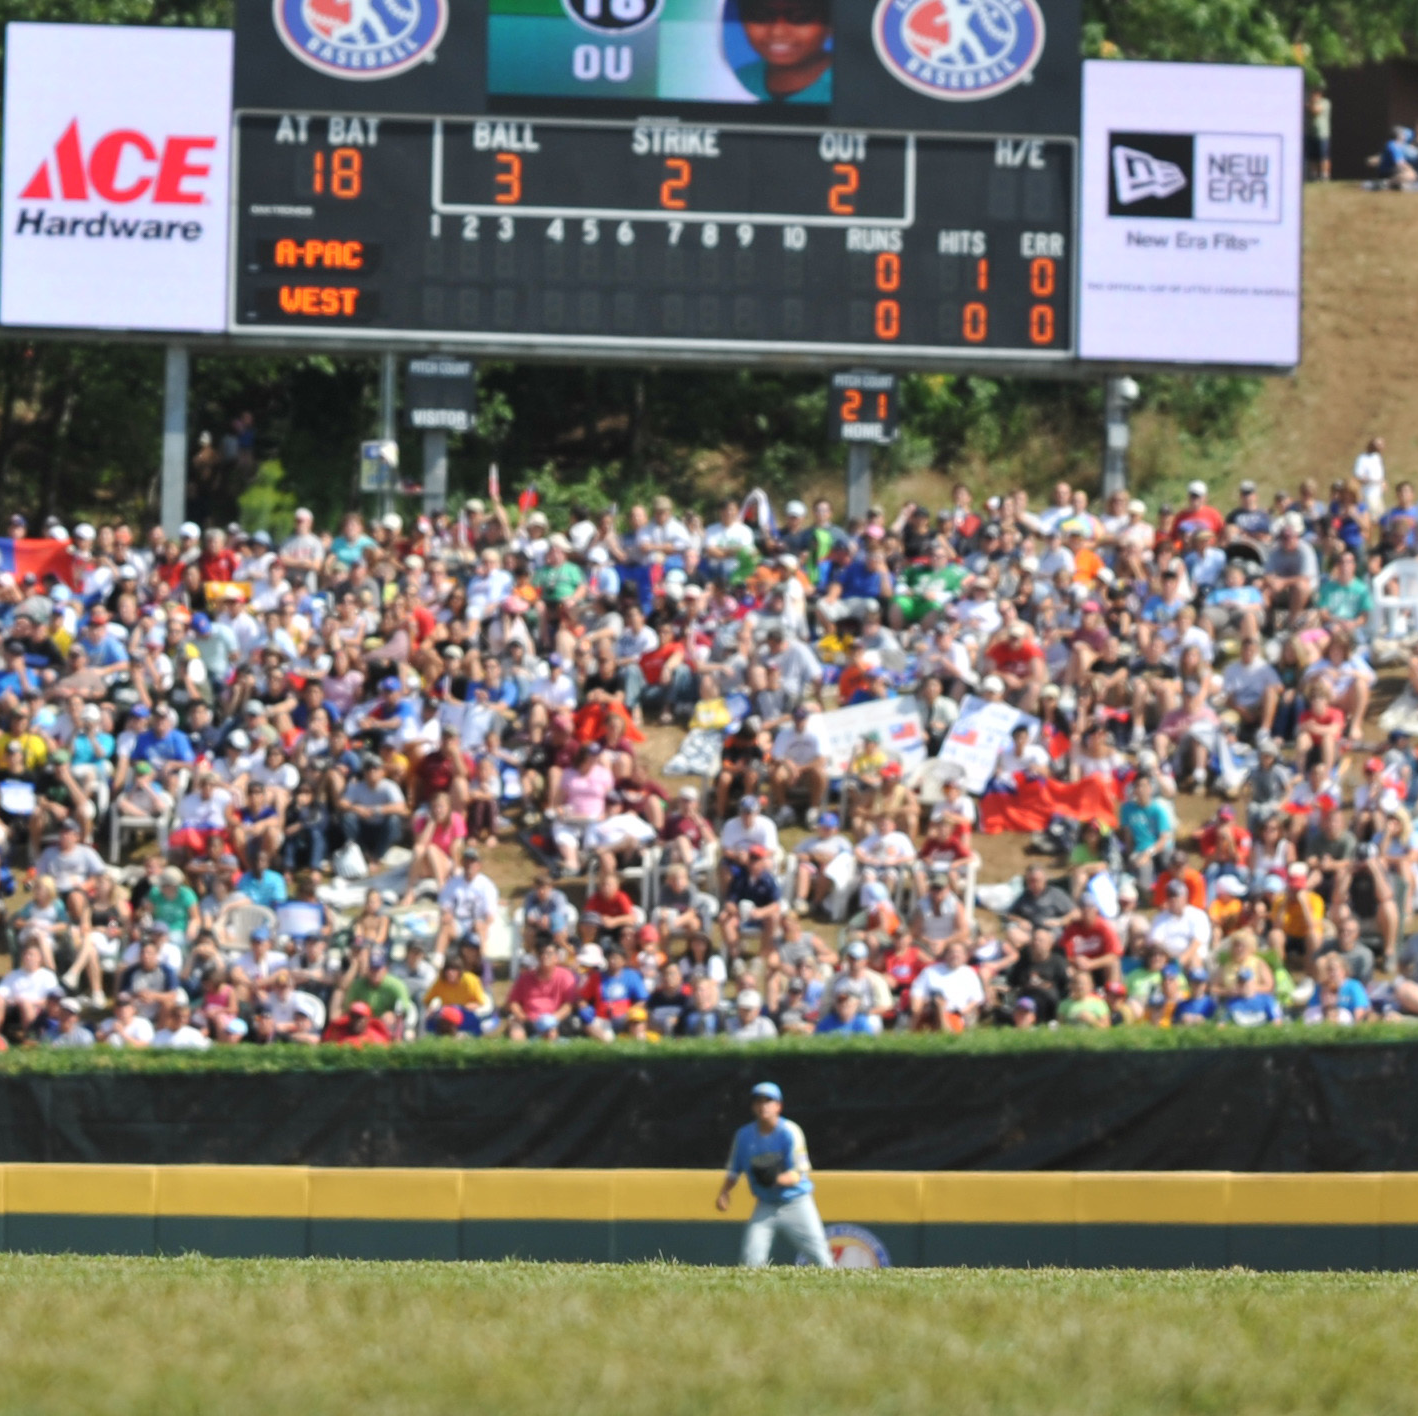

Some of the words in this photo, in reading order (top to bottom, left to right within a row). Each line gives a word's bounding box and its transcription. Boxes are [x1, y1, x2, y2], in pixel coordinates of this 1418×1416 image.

[305, 37, 419, 70] BASEBALL
[572, 44, 632, 81] OU
[905, 55, 1016, 88] BASEBALL
[275, 115, 311, 144] AT
[327, 117, 380, 147] BAT
[473, 121, 540, 152] BALL
[631, 126, 720, 157] STRIKE
[819, 132, 868, 161] OUT
[18, 116, 217, 205] ACE
[995, 140, 1046, 169] H/E
[1207, 153, 1269, 177] NEW
[313, 148, 363, 199] 18
[494, 152, 523, 204] 3
[660, 158, 692, 209] 2
[828, 164, 860, 215] 2
[1208, 178, 1269, 209] ERA
[15, 209, 203, 242] Hardware
[430, 214, 441, 238] 1
[463, 216, 480, 240] 2
[497, 217, 515, 242] 3
[546, 218, 564, 242] 4
[583, 219, 600, 244] 5
[617, 220, 634, 245] 6
[668, 222, 683, 246] 7
[702, 223, 718, 247] 8
[737, 224, 754, 247] 9
[784, 226, 806, 250] 10
[847, 228, 903, 253] RUNS
[1126, 231, 1168, 248] New
[1175, 233, 1207, 250] Era
[275, 239, 363, 270] A-PAC
[938, 231, 986, 255] HITS
[1021, 233, 1064, 258] ERR
[876, 252, 901, 293] 0
[977, 258, 988, 292] 1
[1030, 258, 1055, 297] 0
[279, 286, 360, 316] WEST
[875, 300, 900, 341] 0
[963, 302, 988, 342] 0
[1030, 305, 1055, 344] 0
[412, 409, 467, 428] VISITOR
[841, 389, 888, 422] 21
[843, 422, 883, 440] HOME
